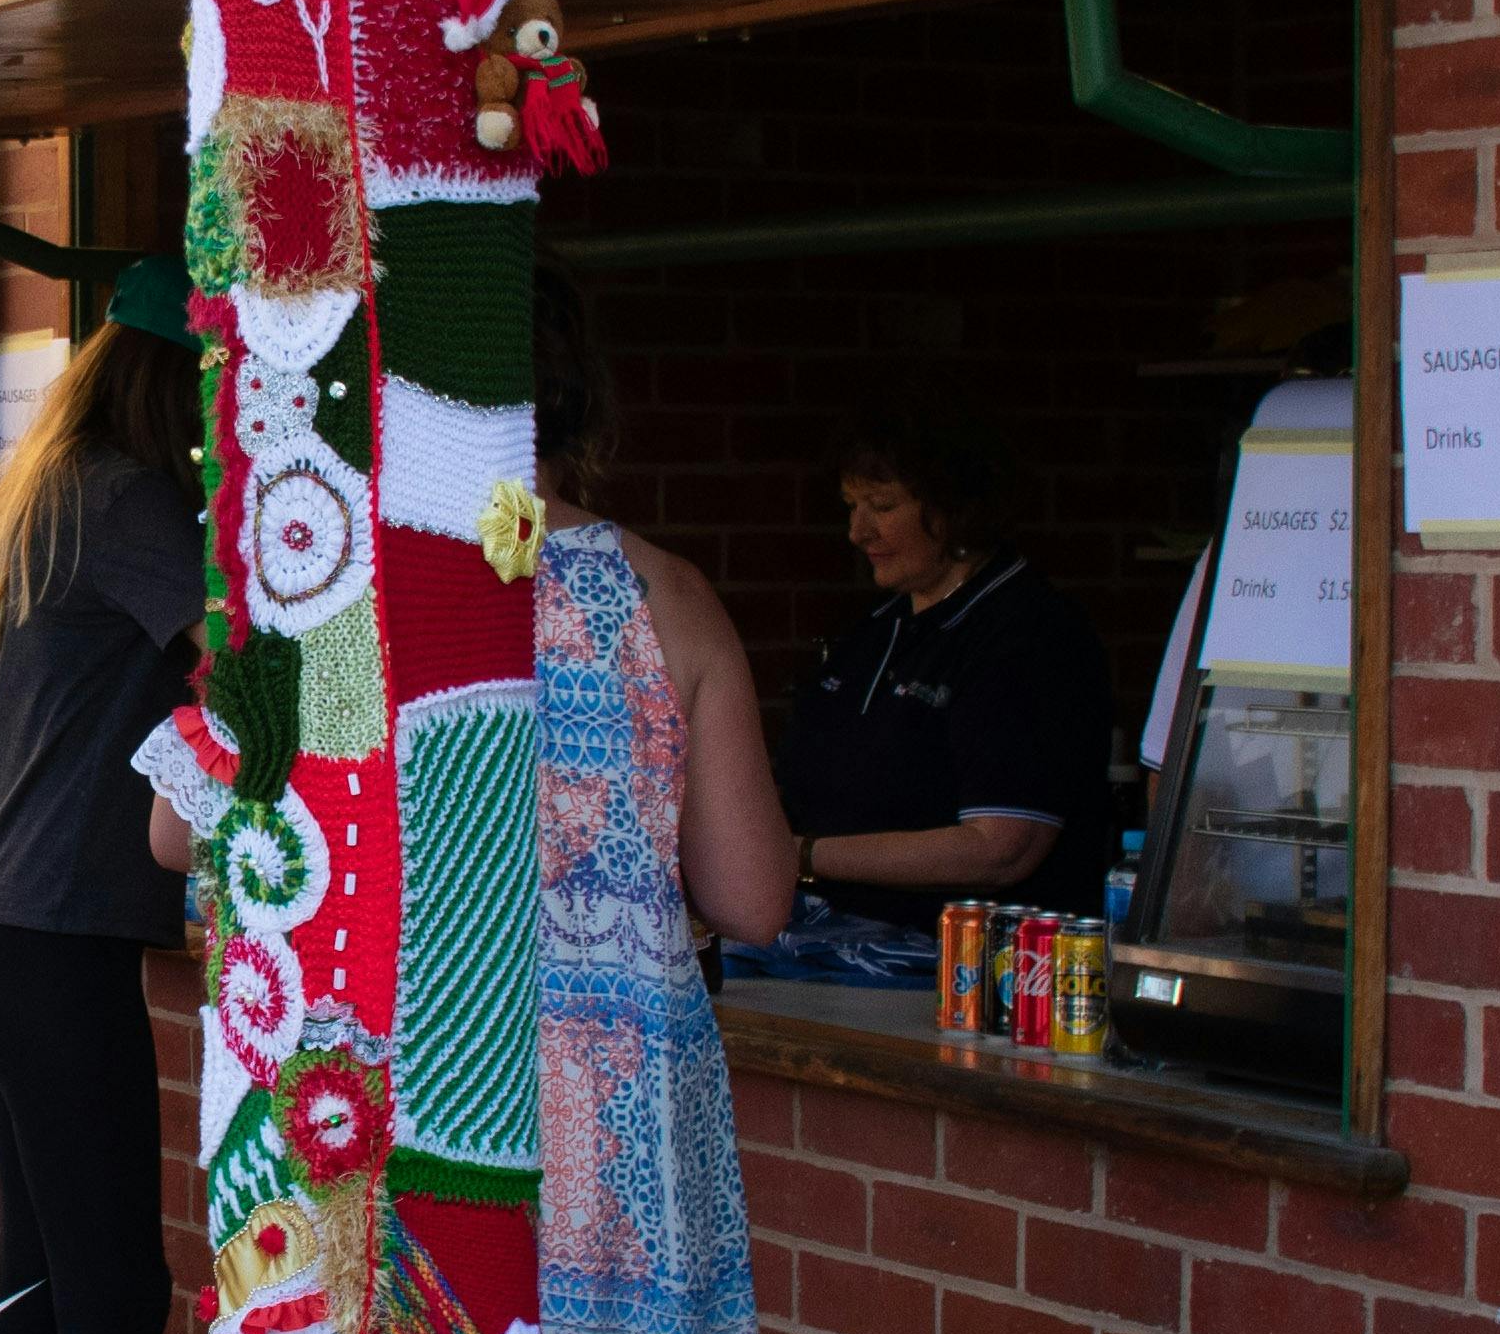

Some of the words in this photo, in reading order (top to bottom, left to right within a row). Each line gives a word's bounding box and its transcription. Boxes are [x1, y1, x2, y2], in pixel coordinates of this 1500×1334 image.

[1425, 425, 1482, 450] Drinks
[1242, 511, 1319, 532] SAUSAGES
[1230, 578, 1278, 599] Drinks
